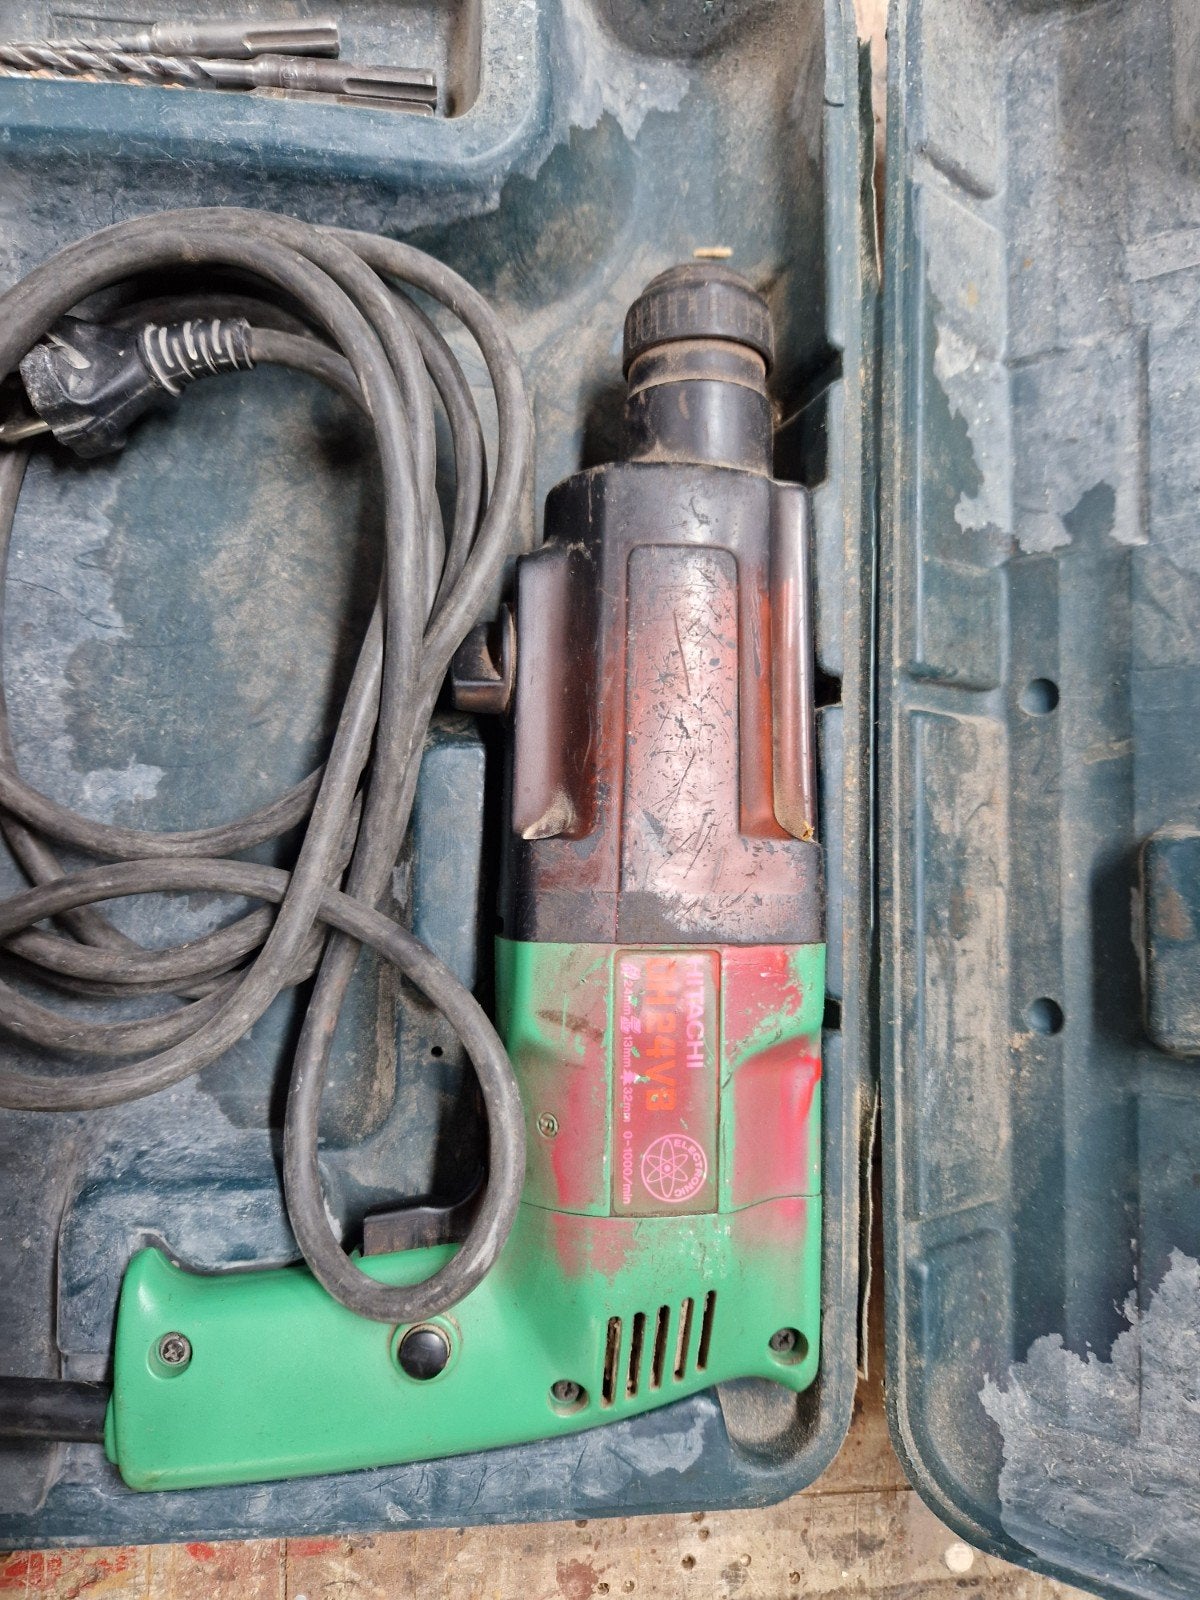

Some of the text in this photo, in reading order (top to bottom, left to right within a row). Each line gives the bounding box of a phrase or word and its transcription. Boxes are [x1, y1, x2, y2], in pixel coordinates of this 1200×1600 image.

[686, 957, 705, 1068] HITACHI
[622, 980, 634, 1205] 24mm 13mm 32mm 0-1000/min
[673, 1138, 705, 1198] ELECTRONIC
